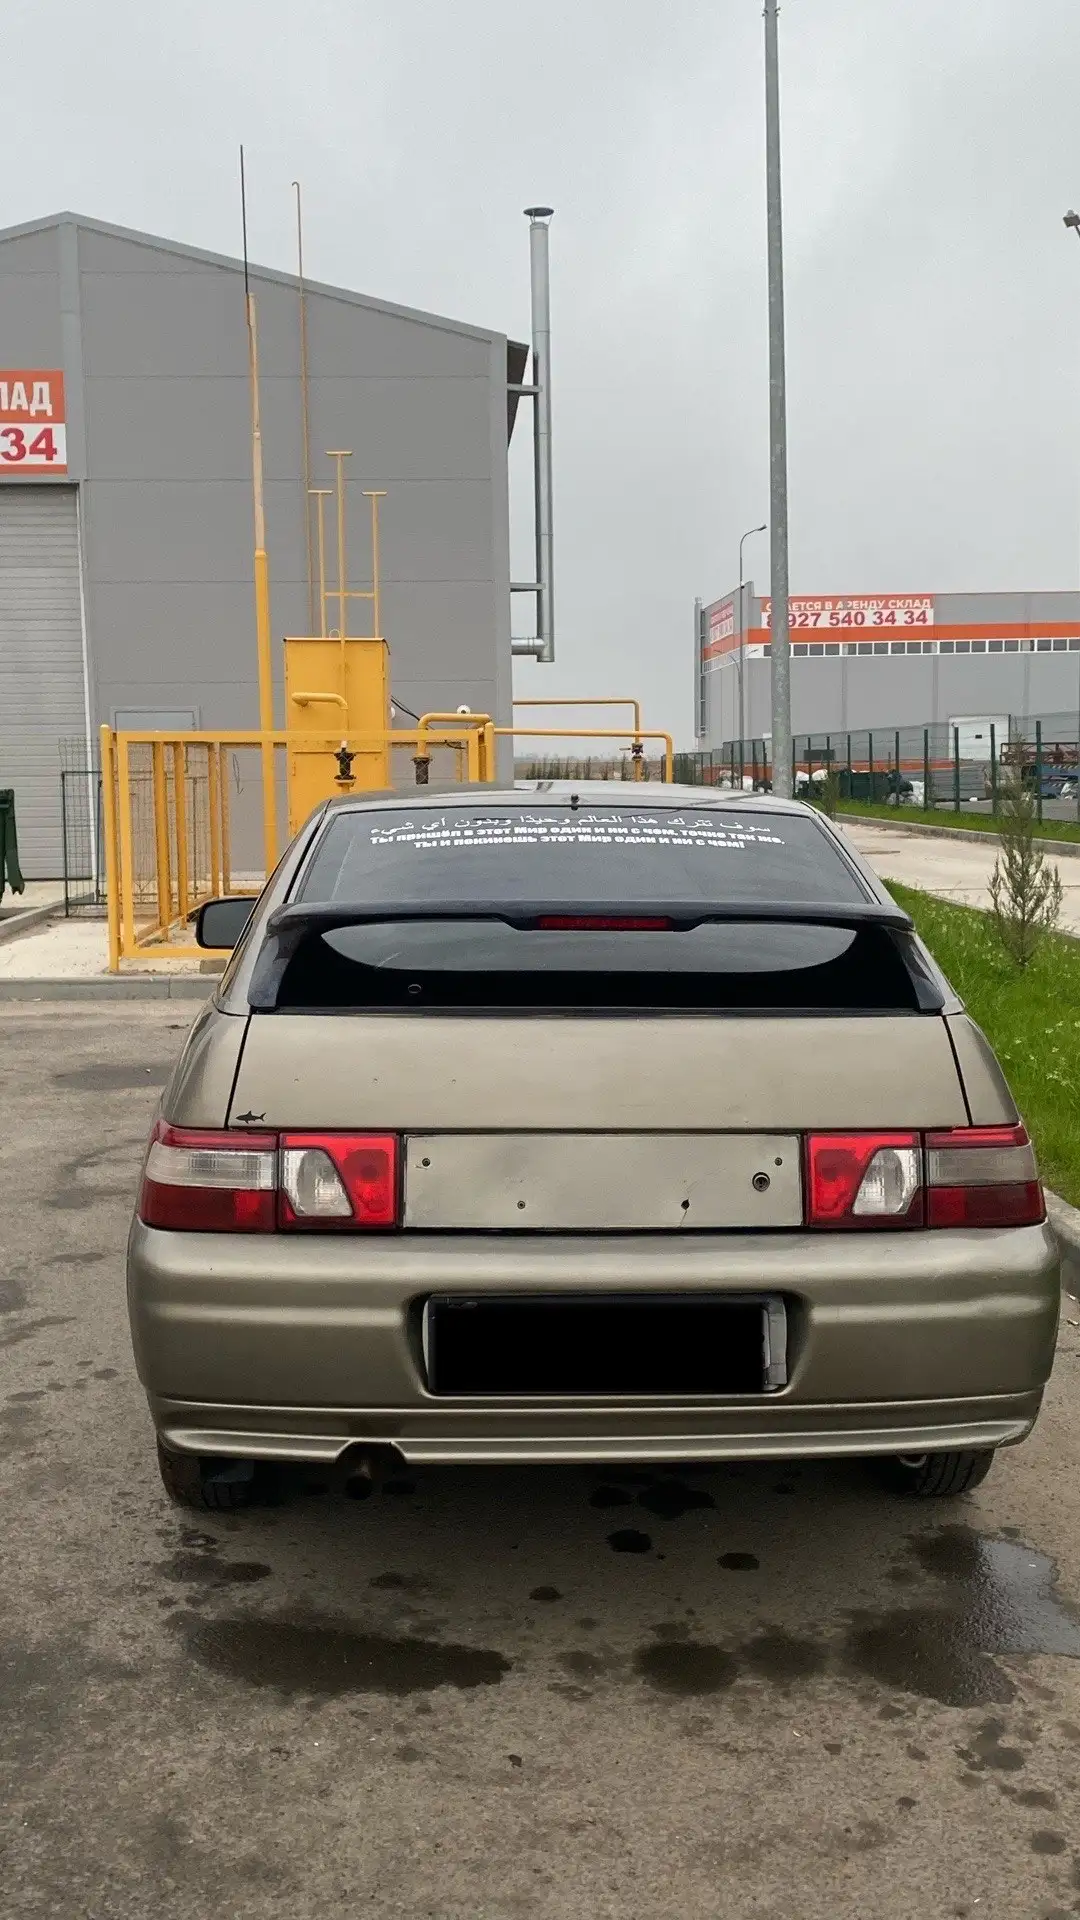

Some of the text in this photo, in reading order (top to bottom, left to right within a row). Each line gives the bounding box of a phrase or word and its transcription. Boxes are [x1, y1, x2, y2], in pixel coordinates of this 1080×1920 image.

[0, 427, 57, 461] 34
[825, 601, 833, 610] В
[888, 599, 931, 609] СКЛАД
[787, 612, 821, 627] 927
[829, 611, 865, 626] 540
[872, 610, 896, 625] 34
[904, 610, 928, 624] 34
